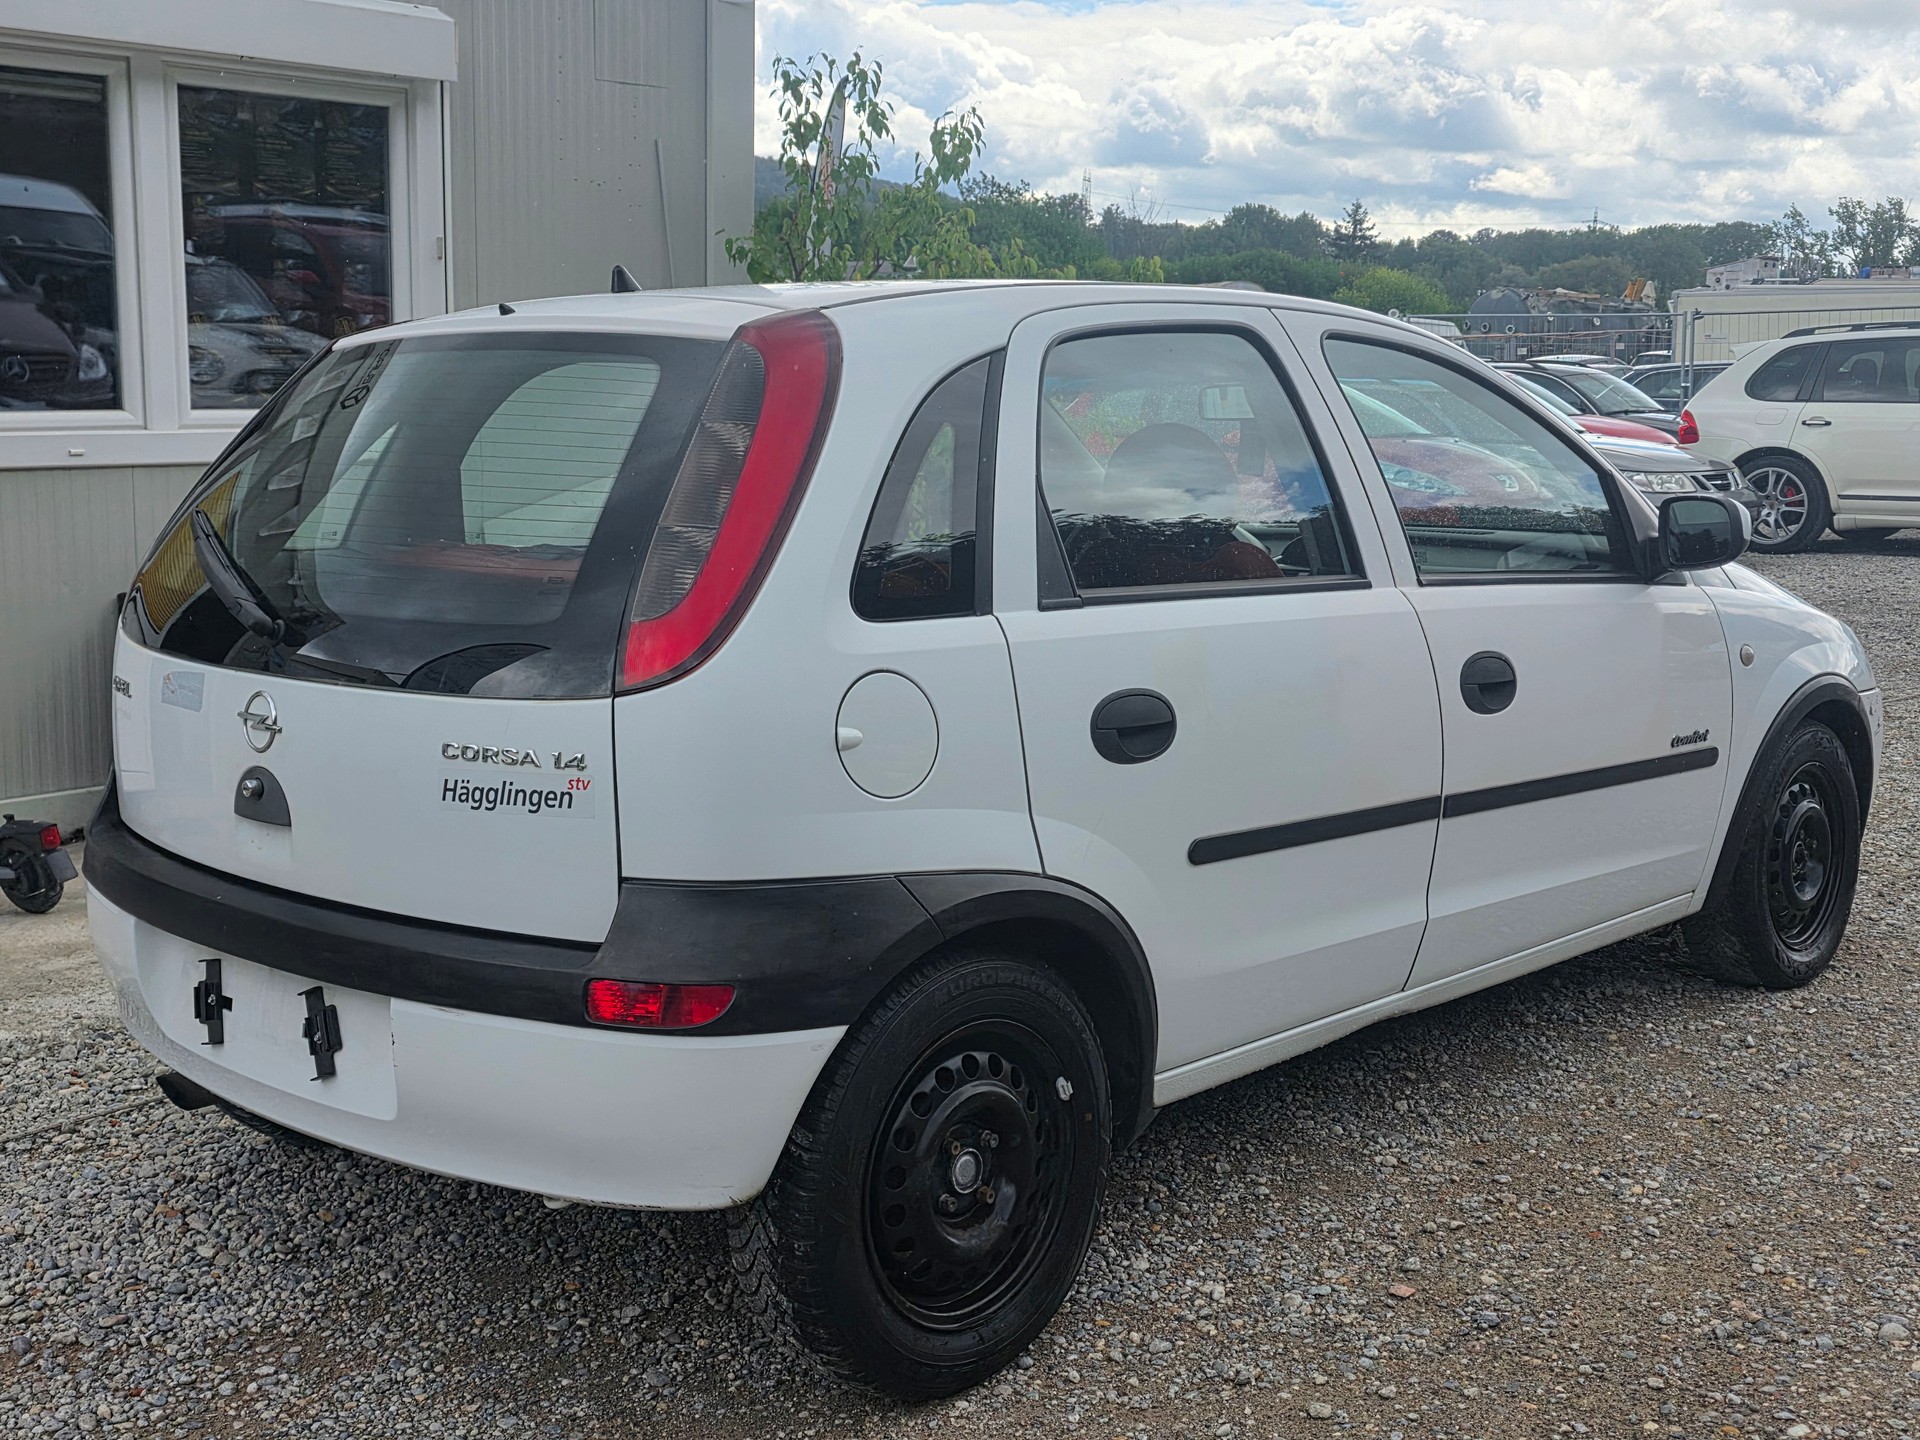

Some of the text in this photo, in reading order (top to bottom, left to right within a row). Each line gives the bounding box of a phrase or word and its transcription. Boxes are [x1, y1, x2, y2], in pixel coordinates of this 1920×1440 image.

[441, 742, 541, 768] CORSA
[442, 778, 573, 813] Hägglingen
[567, 777, 590, 791] stv
